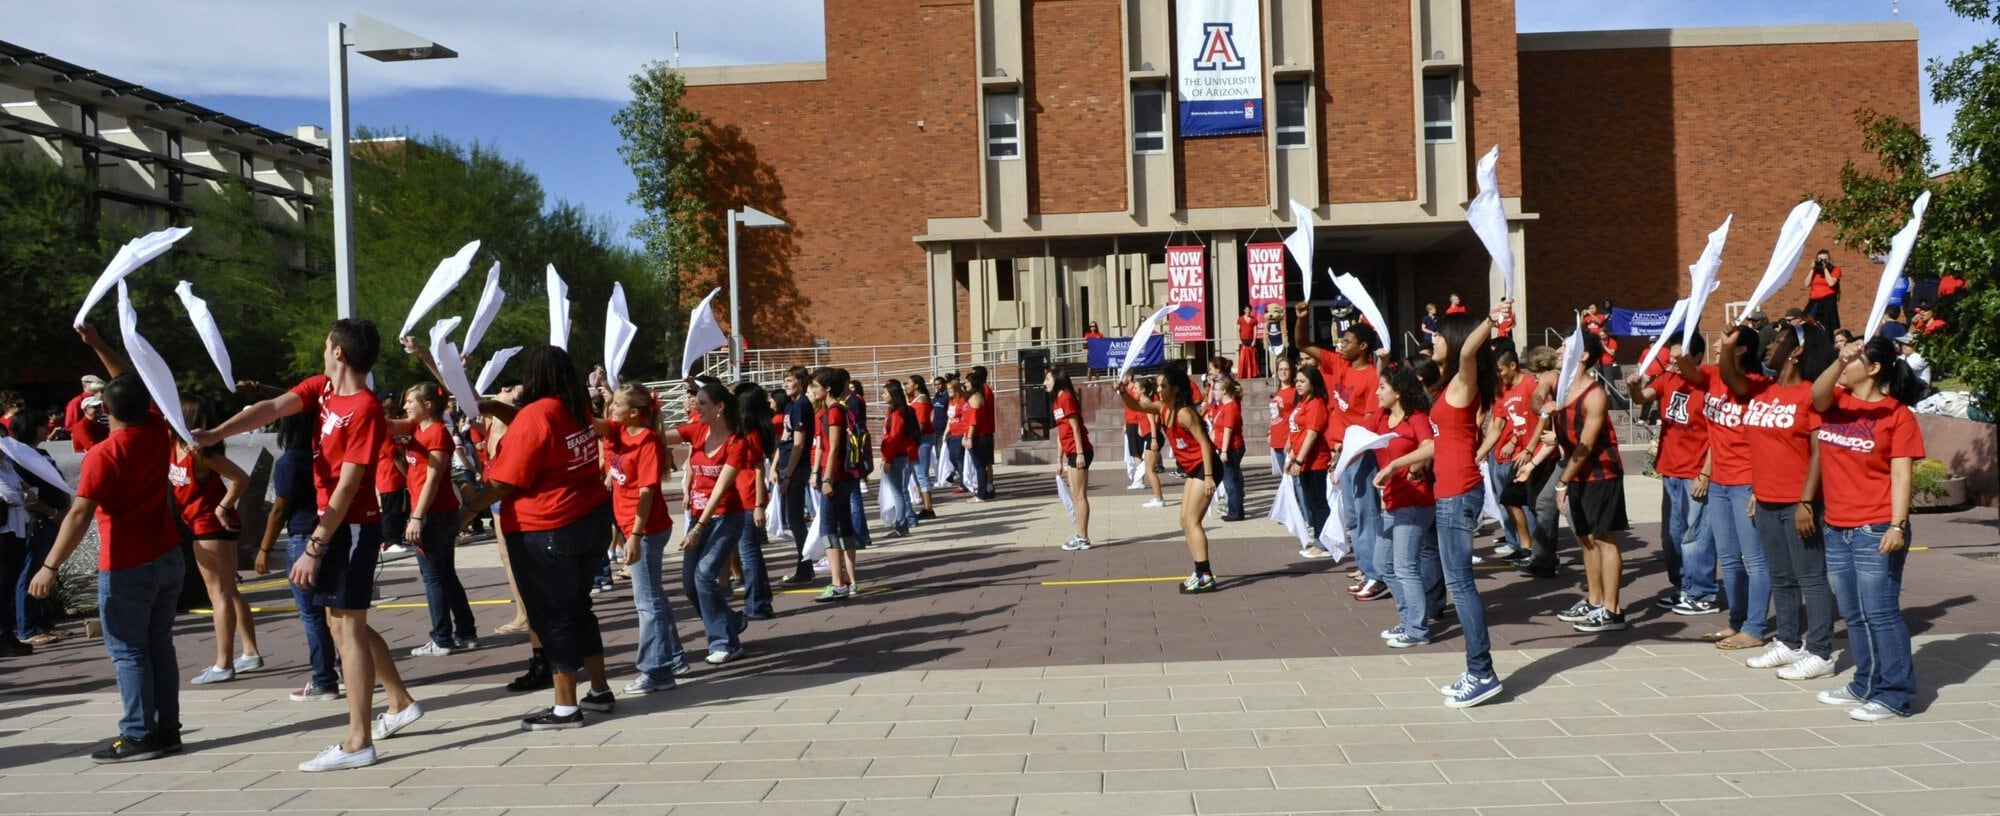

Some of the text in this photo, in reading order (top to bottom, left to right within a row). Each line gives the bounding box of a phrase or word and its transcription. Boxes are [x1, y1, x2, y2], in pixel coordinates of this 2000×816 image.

[1193, 23, 1245, 71] A
[1184, 76, 1256, 86] THE UNIVERSITY
[1192, 87, 1249, 97] OF ARIZONA
[1169, 251, 1201, 266] NOW
[1250, 248, 1281, 263] NOW
[1169, 265, 1202, 287] WE
[1249, 262, 1283, 284] WE
[1169, 286, 1203, 303] CAN!
[1251, 283, 1283, 300] CAN!
[1174, 324, 1202, 332] ARIZONA
[1665, 391, 1690, 424] A
